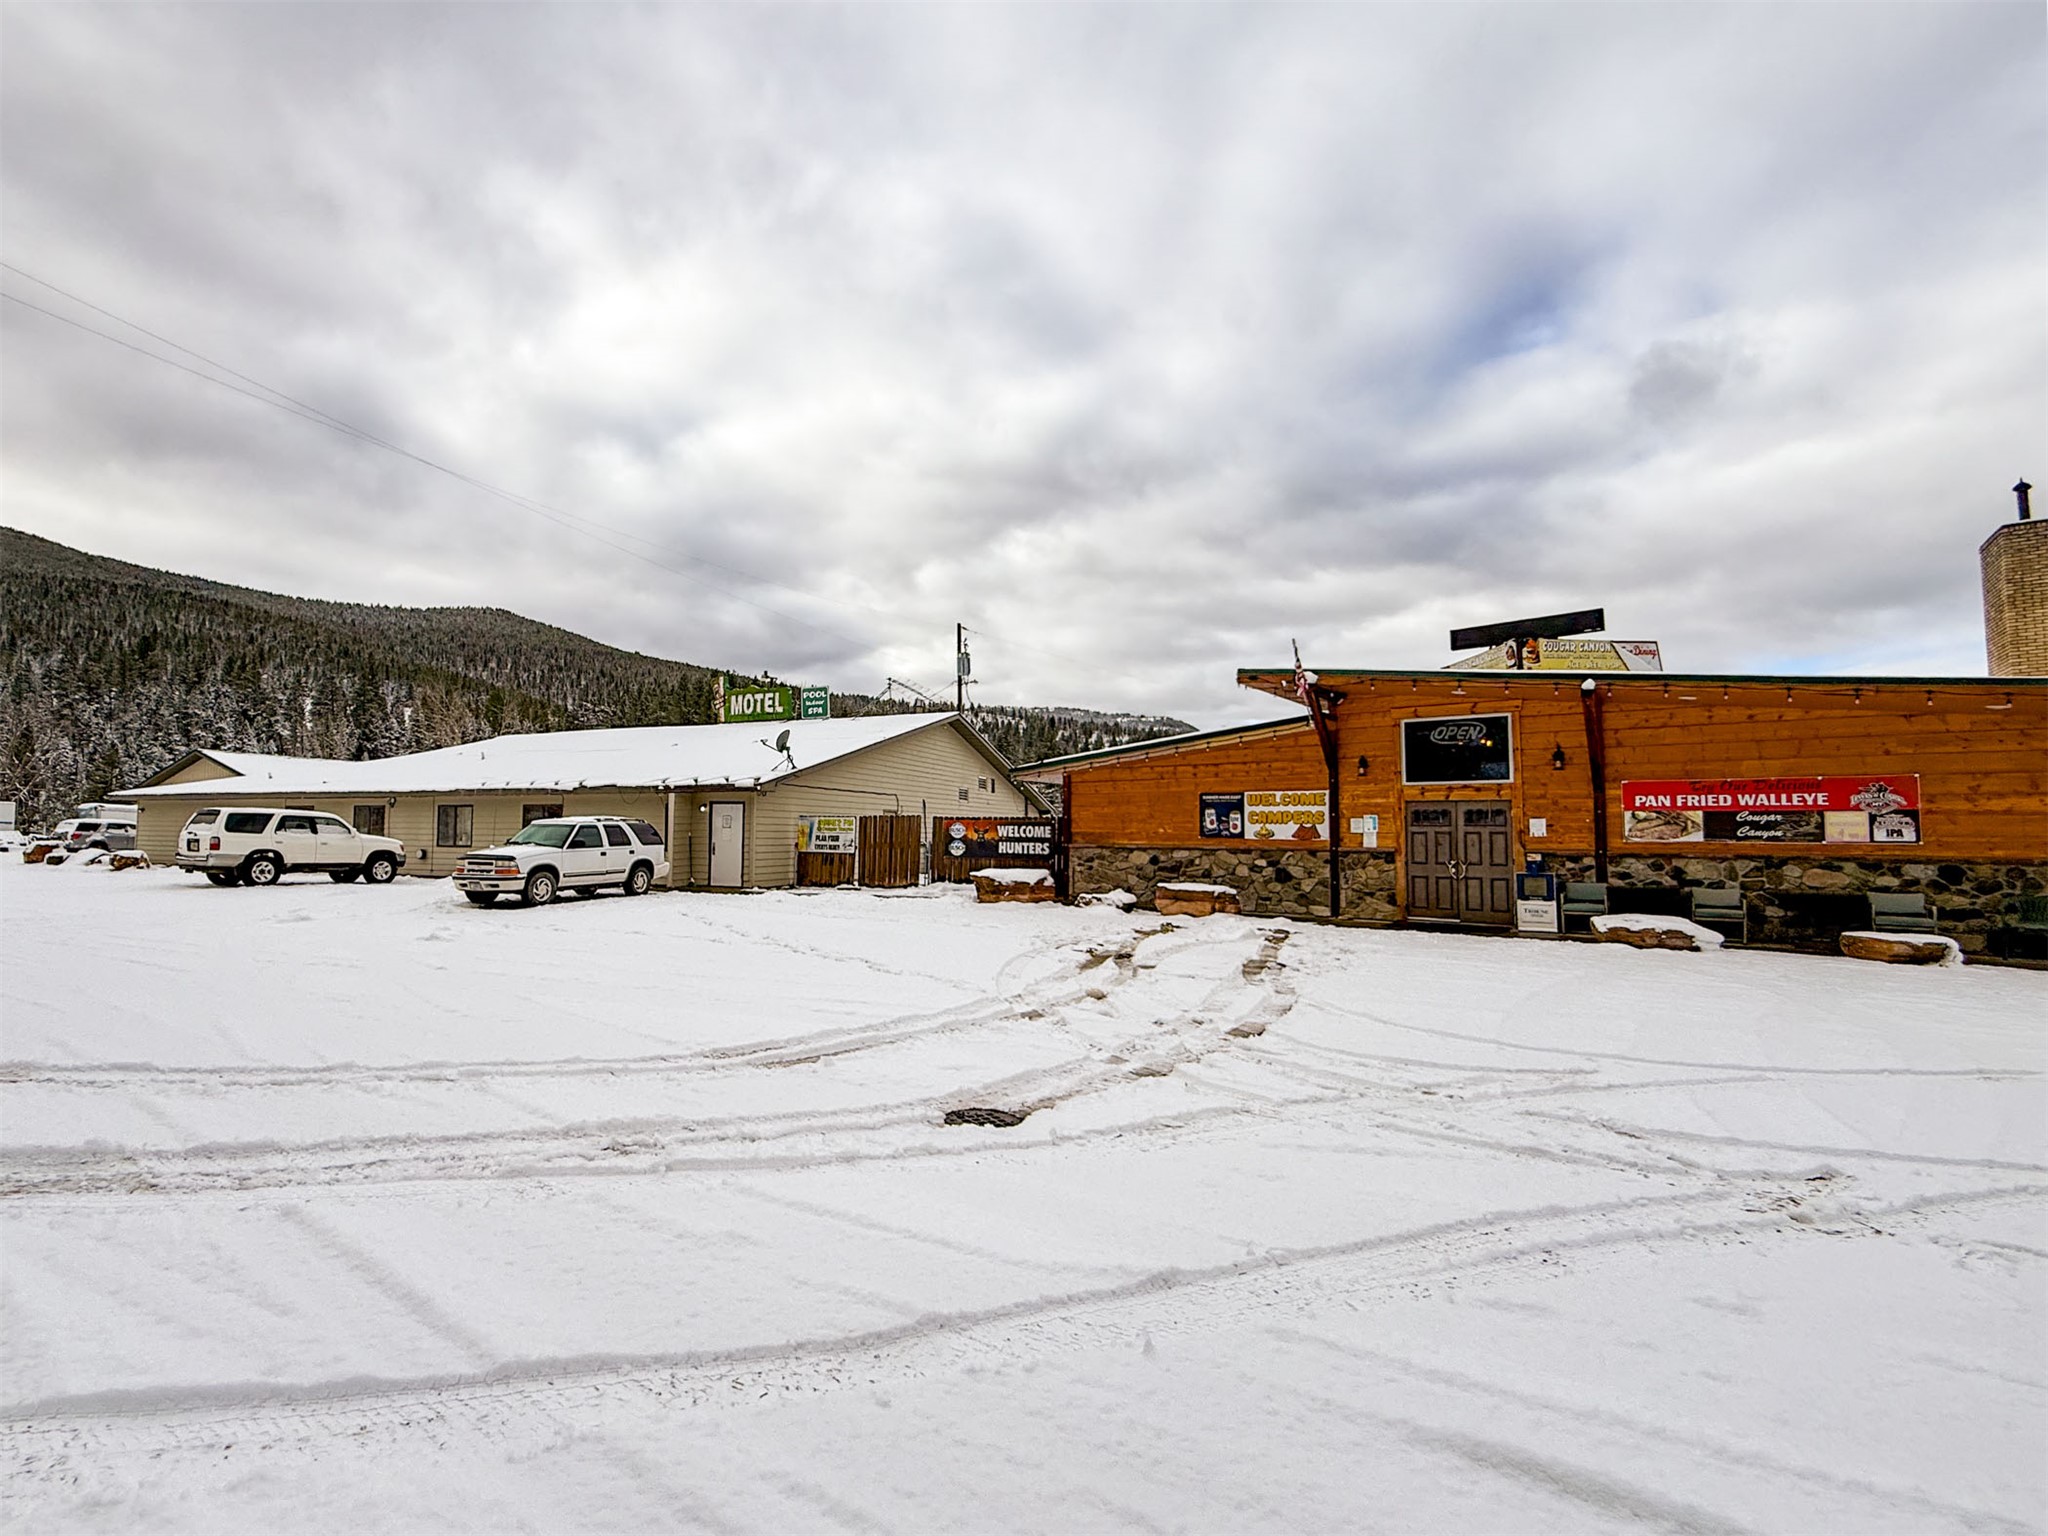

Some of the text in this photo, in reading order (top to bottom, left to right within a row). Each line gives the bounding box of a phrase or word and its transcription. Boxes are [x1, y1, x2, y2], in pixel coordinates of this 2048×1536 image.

[1542, 641, 1577, 653] COUGAR
[1579, 641, 1612, 653] CANYON
[803, 690, 827, 699] POOL
[730, 692, 784, 716] MOTEL
[807, 707, 823, 715] SPA
[1434, 726, 1481, 740] OPEN
[1719, 779, 1748, 792] Our
[1246, 793, 1326, 806] WELCOME
[1635, 793, 1829, 807] PAN FRIED WALLEYE
[1248, 811, 1325, 825] CAMPERS
[1736, 811, 1783, 824] Cougar
[996, 825, 1051, 838] WELCOME
[1736, 826, 1784, 839] Canyon
[1886, 829, 1904, 838] IPA
[998, 842, 1050, 855] HUNTERS
